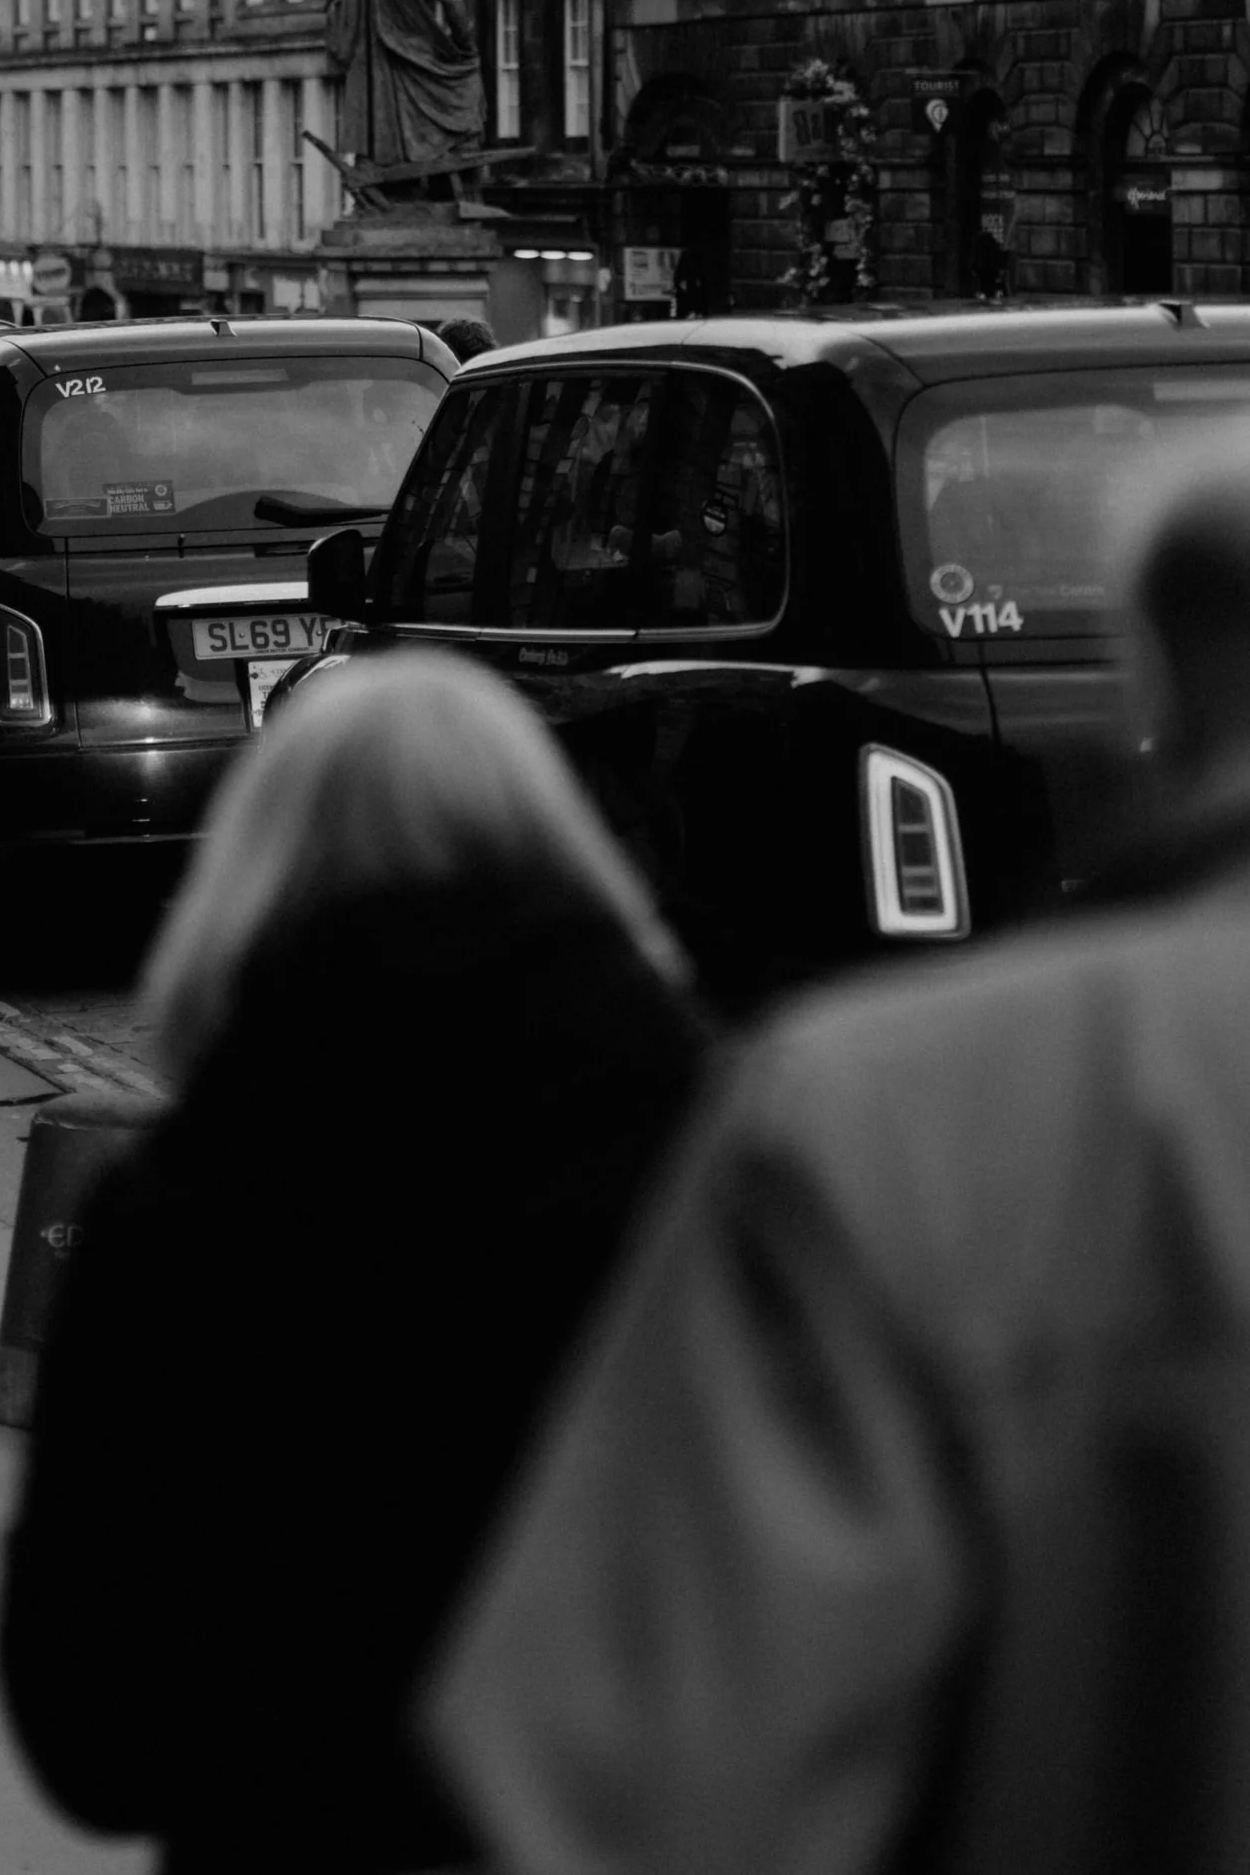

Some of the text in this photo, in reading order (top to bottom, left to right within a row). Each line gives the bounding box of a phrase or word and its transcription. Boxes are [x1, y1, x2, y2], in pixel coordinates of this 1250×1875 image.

[913, 80, 959, 91] TOURIST
[55, 376, 106, 397] V212
[108, 494, 145, 505] CARBON
[109, 503, 150, 514] NEUTRAL
[938, 600, 1024, 638] V114
[207, 618, 291, 653] SL69
